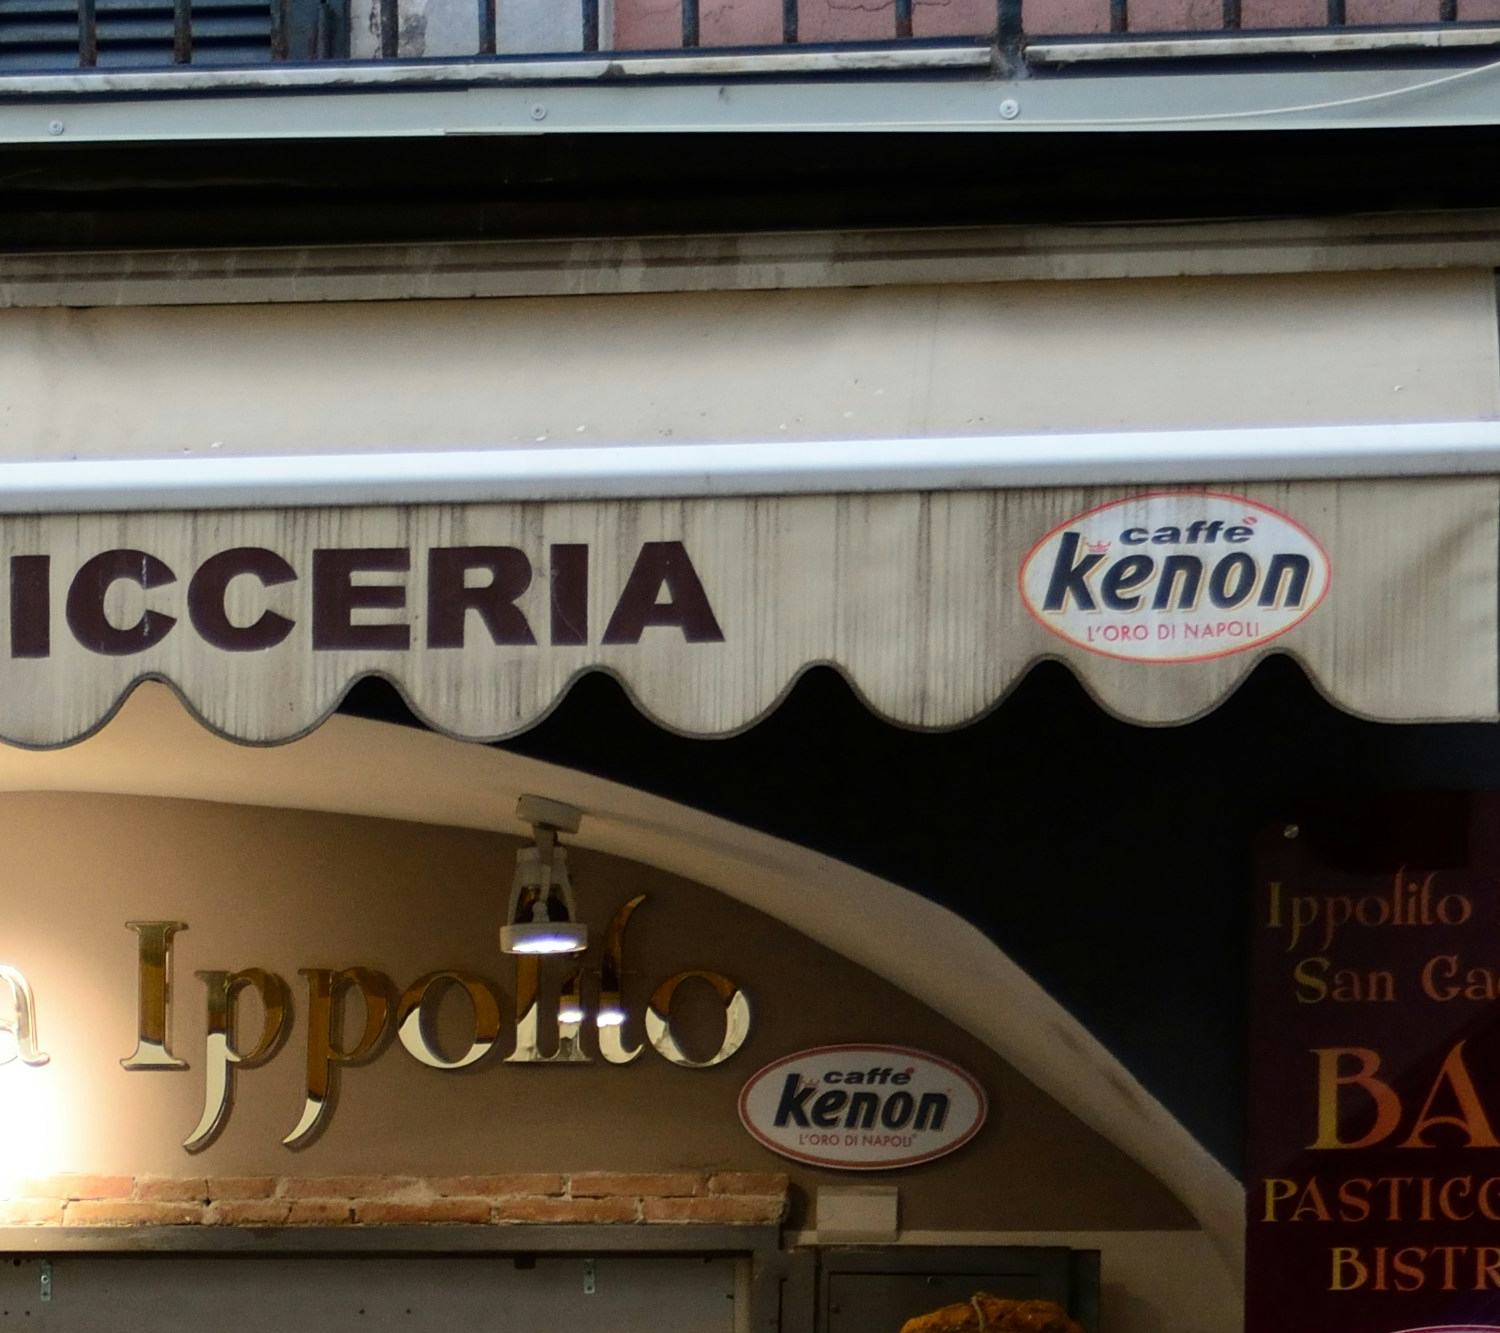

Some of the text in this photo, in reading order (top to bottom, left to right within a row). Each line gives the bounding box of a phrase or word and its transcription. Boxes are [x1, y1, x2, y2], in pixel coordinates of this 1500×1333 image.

[1119, 515, 1260, 548] caffè
[1043, 532, 1312, 612] kenon
[1087, 619, 1260, 643] L'ORO DI NAPOLI
[1267, 866, 1473, 953] Ippolito
[1296, 954, 1395, 1005] San
[773, 1073, 949, 1131] kenon
[799, 1133, 912, 1147] L'ORO DI NAPOLI
